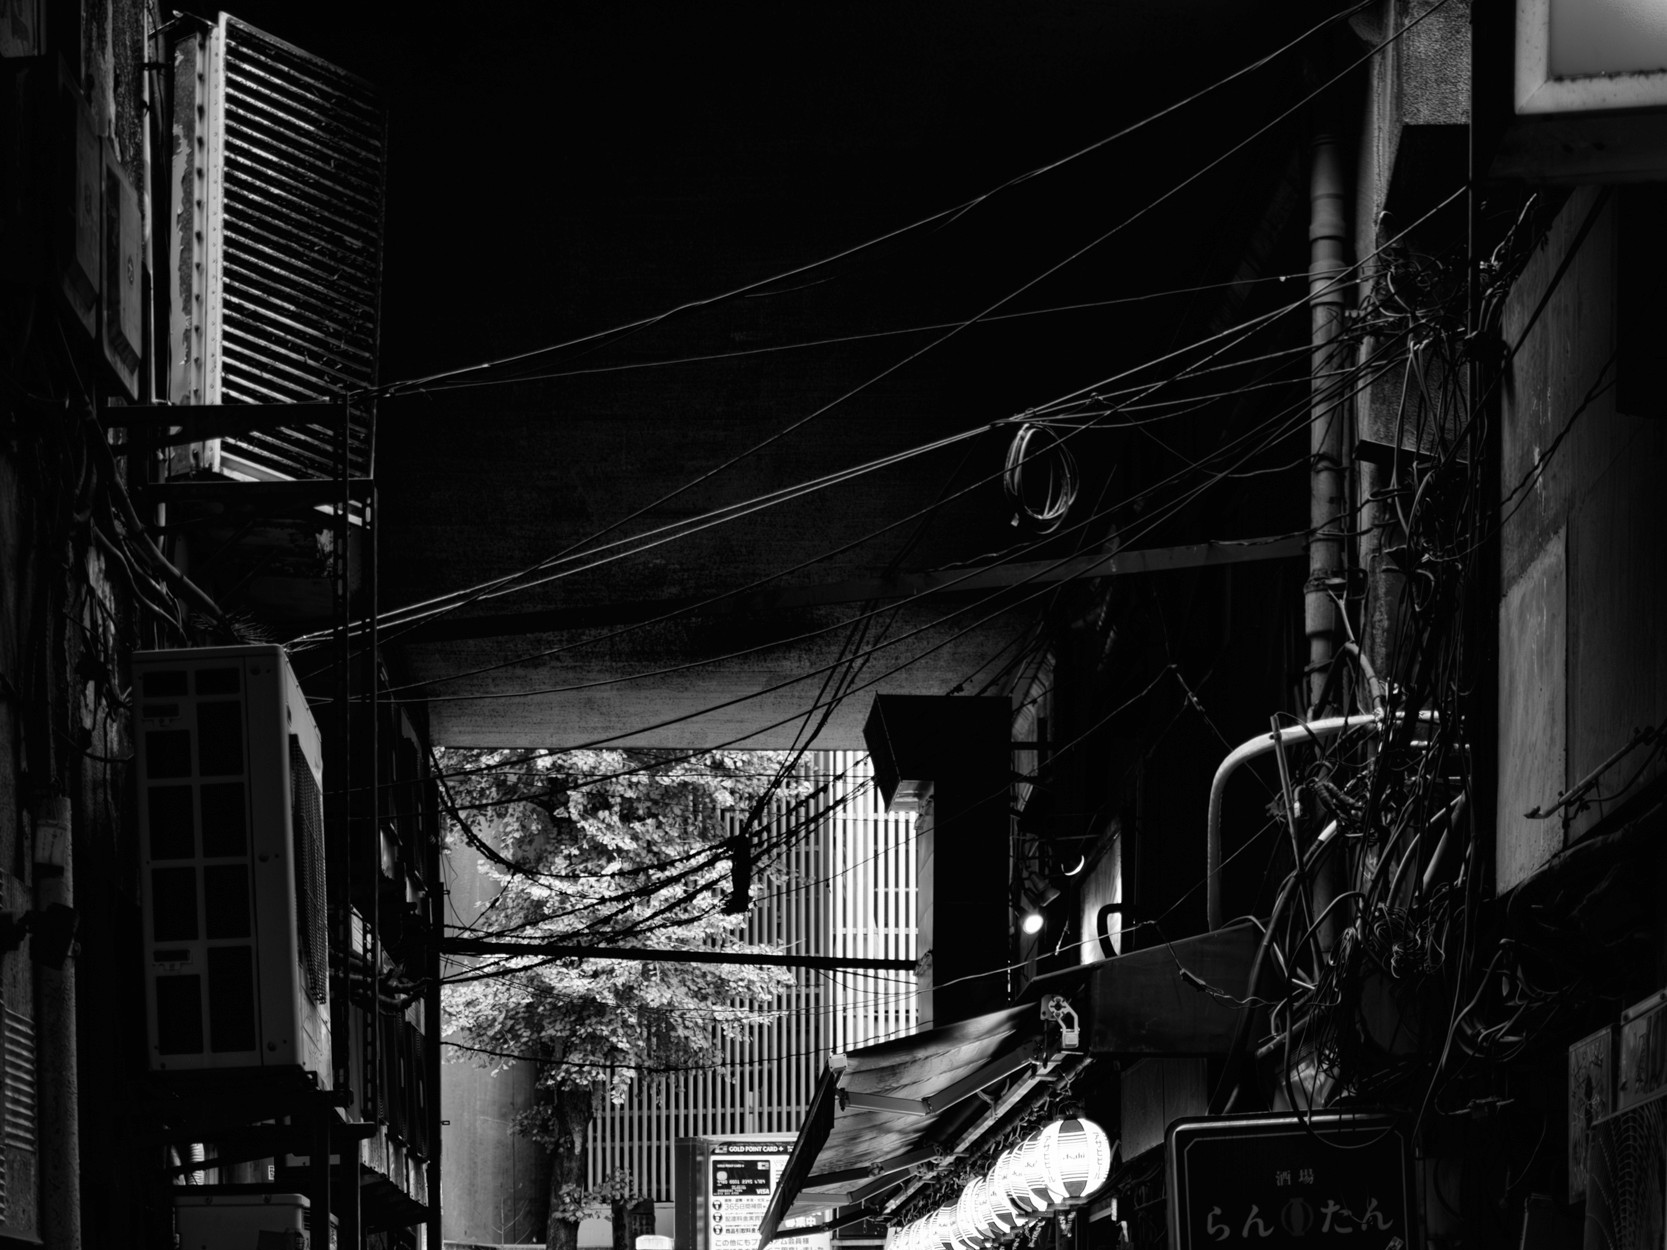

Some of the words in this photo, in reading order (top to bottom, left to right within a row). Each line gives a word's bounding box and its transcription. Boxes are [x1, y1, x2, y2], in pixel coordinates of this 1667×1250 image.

[1275, 1168, 1315, 1187] 酒場
[1206, 1203, 1275, 1242] らん
[1320, 1197, 1394, 1234] たん
